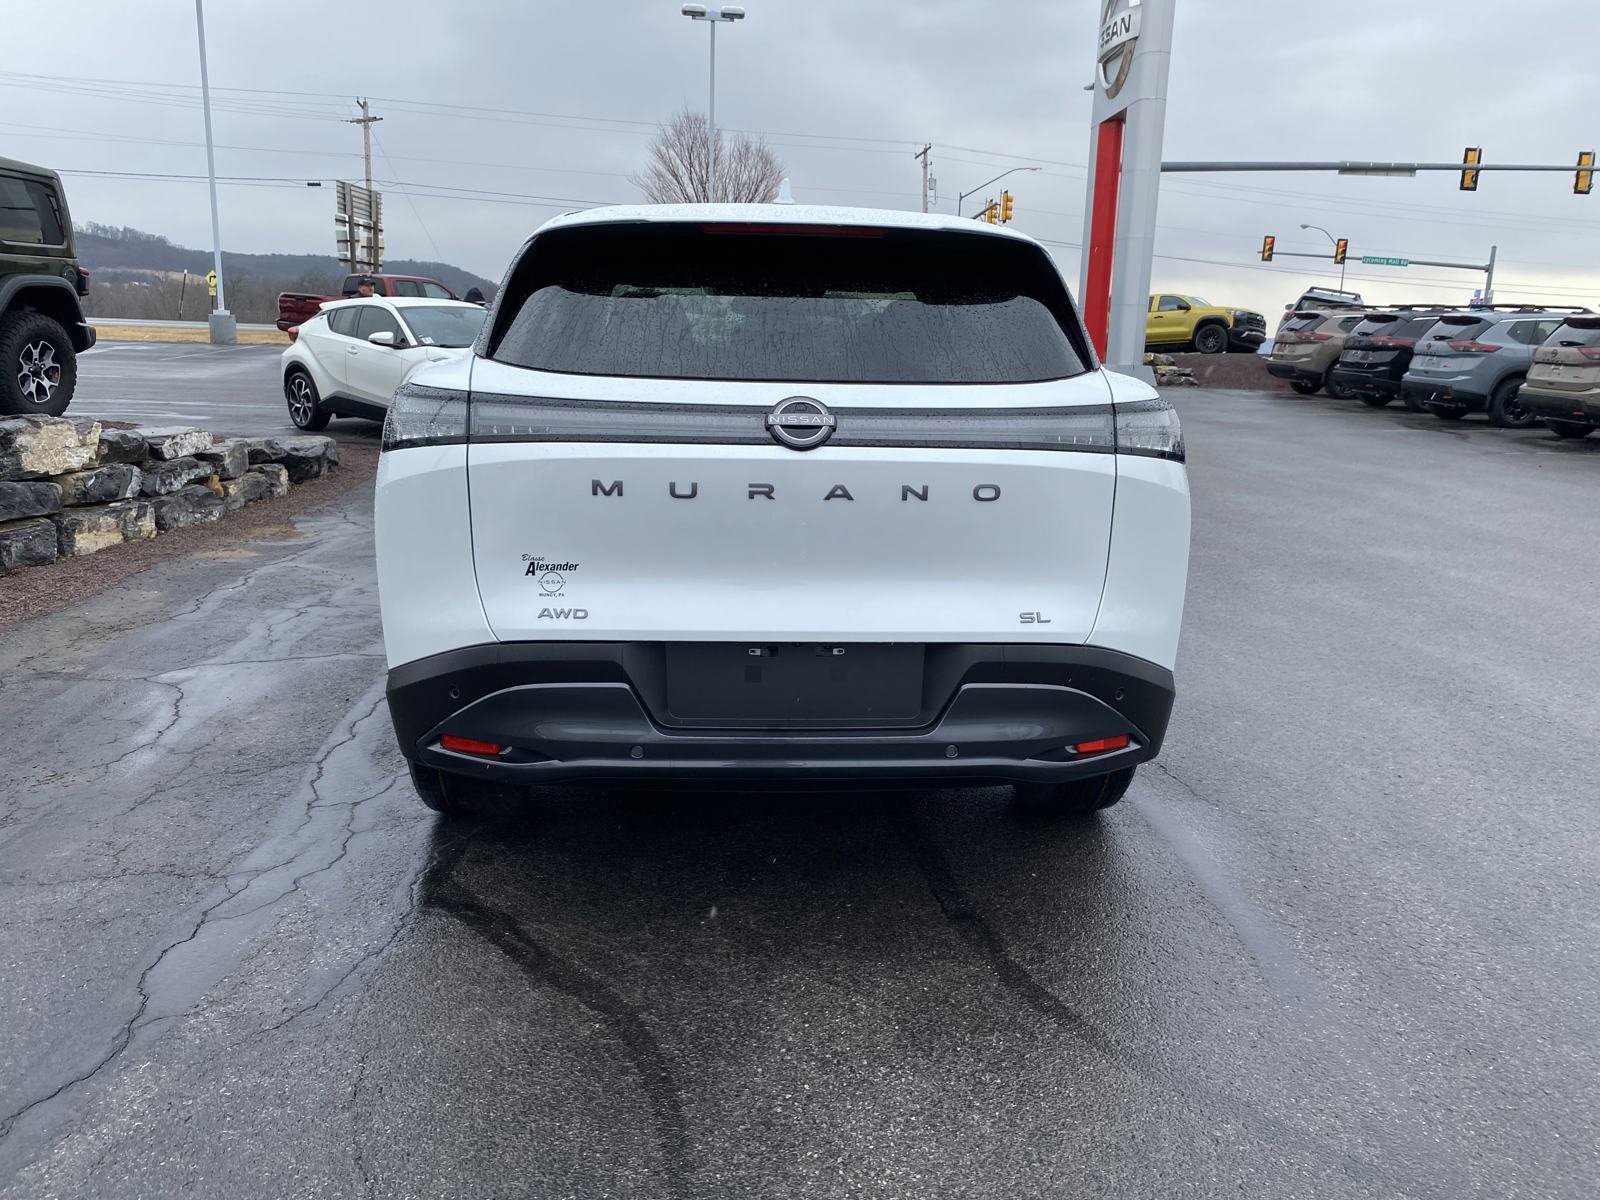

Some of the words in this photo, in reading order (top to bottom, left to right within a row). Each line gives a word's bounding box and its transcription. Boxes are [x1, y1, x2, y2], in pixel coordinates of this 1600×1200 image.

[769, 415, 833, 424] NISSAN
[592, 479, 1001, 502] MURANO
[524, 561, 580, 576] Alexander
[537, 607, 589, 620] AWD
[1019, 611, 1052, 624] SL
